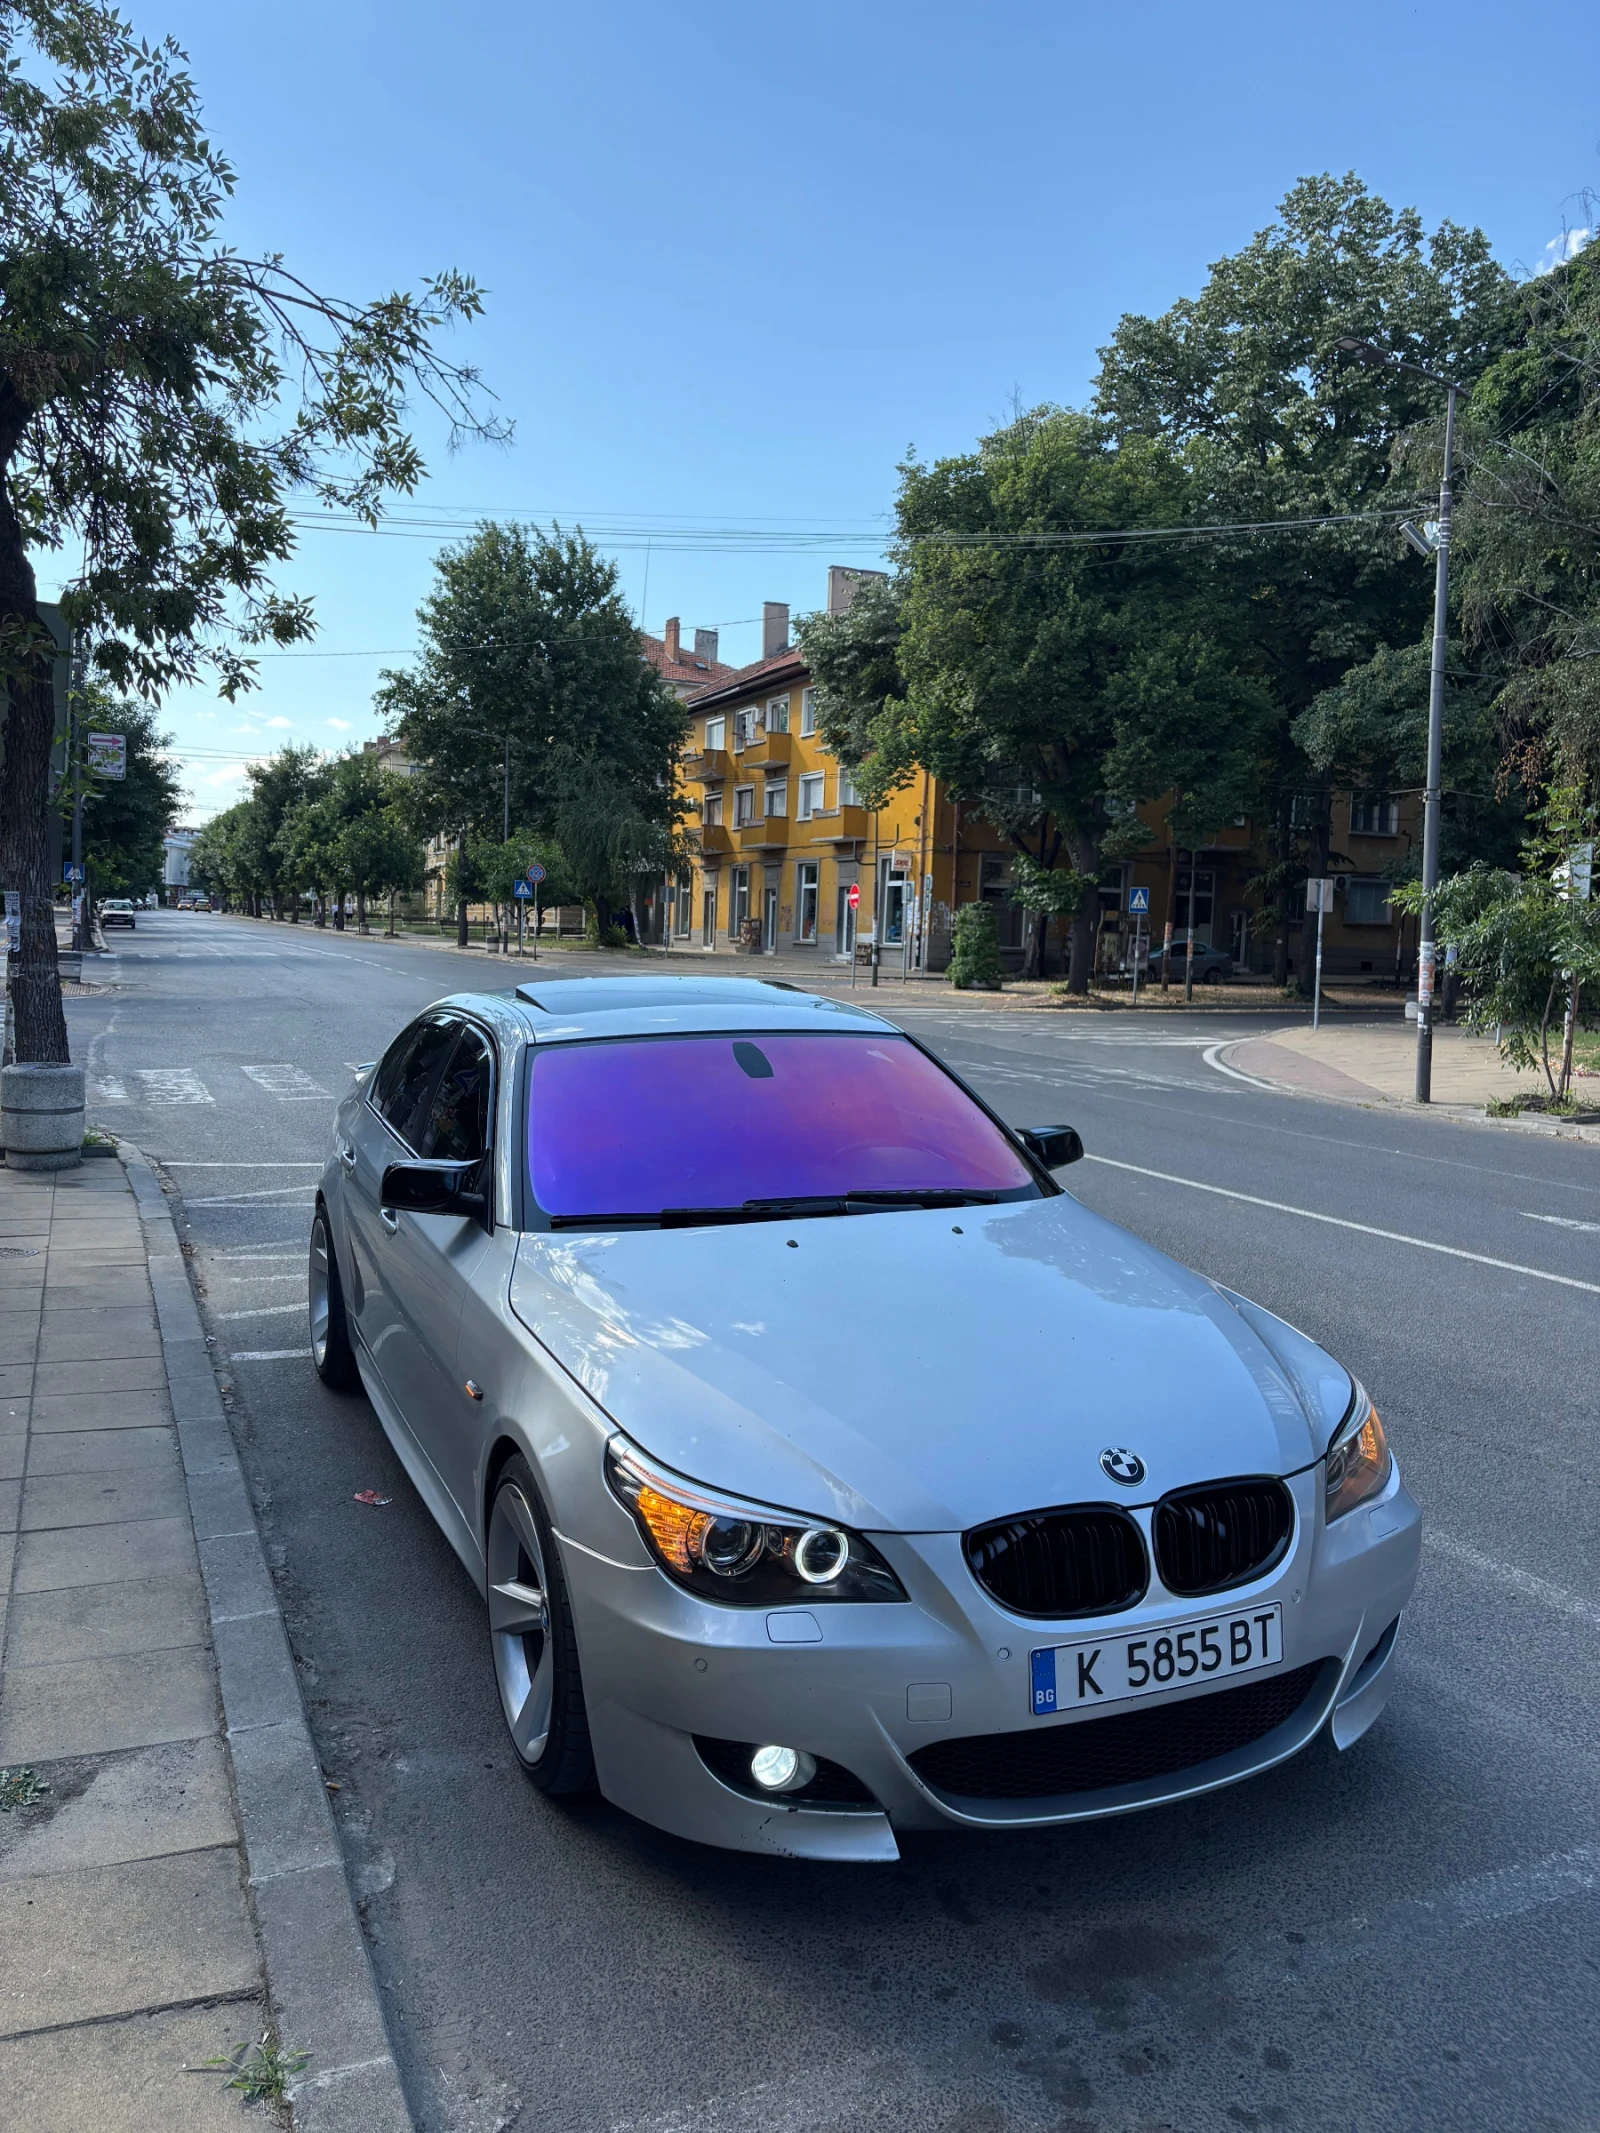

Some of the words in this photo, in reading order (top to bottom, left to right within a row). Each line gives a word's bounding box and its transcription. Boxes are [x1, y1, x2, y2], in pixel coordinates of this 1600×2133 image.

[1102, 1447, 1135, 1461] BMW
[1077, 1649, 1104, 1698] K
[1127, 1626, 1222, 1687] 5855
[1229, 1612, 1275, 1666] BT
[1036, 1689, 1055, 1705] BG
